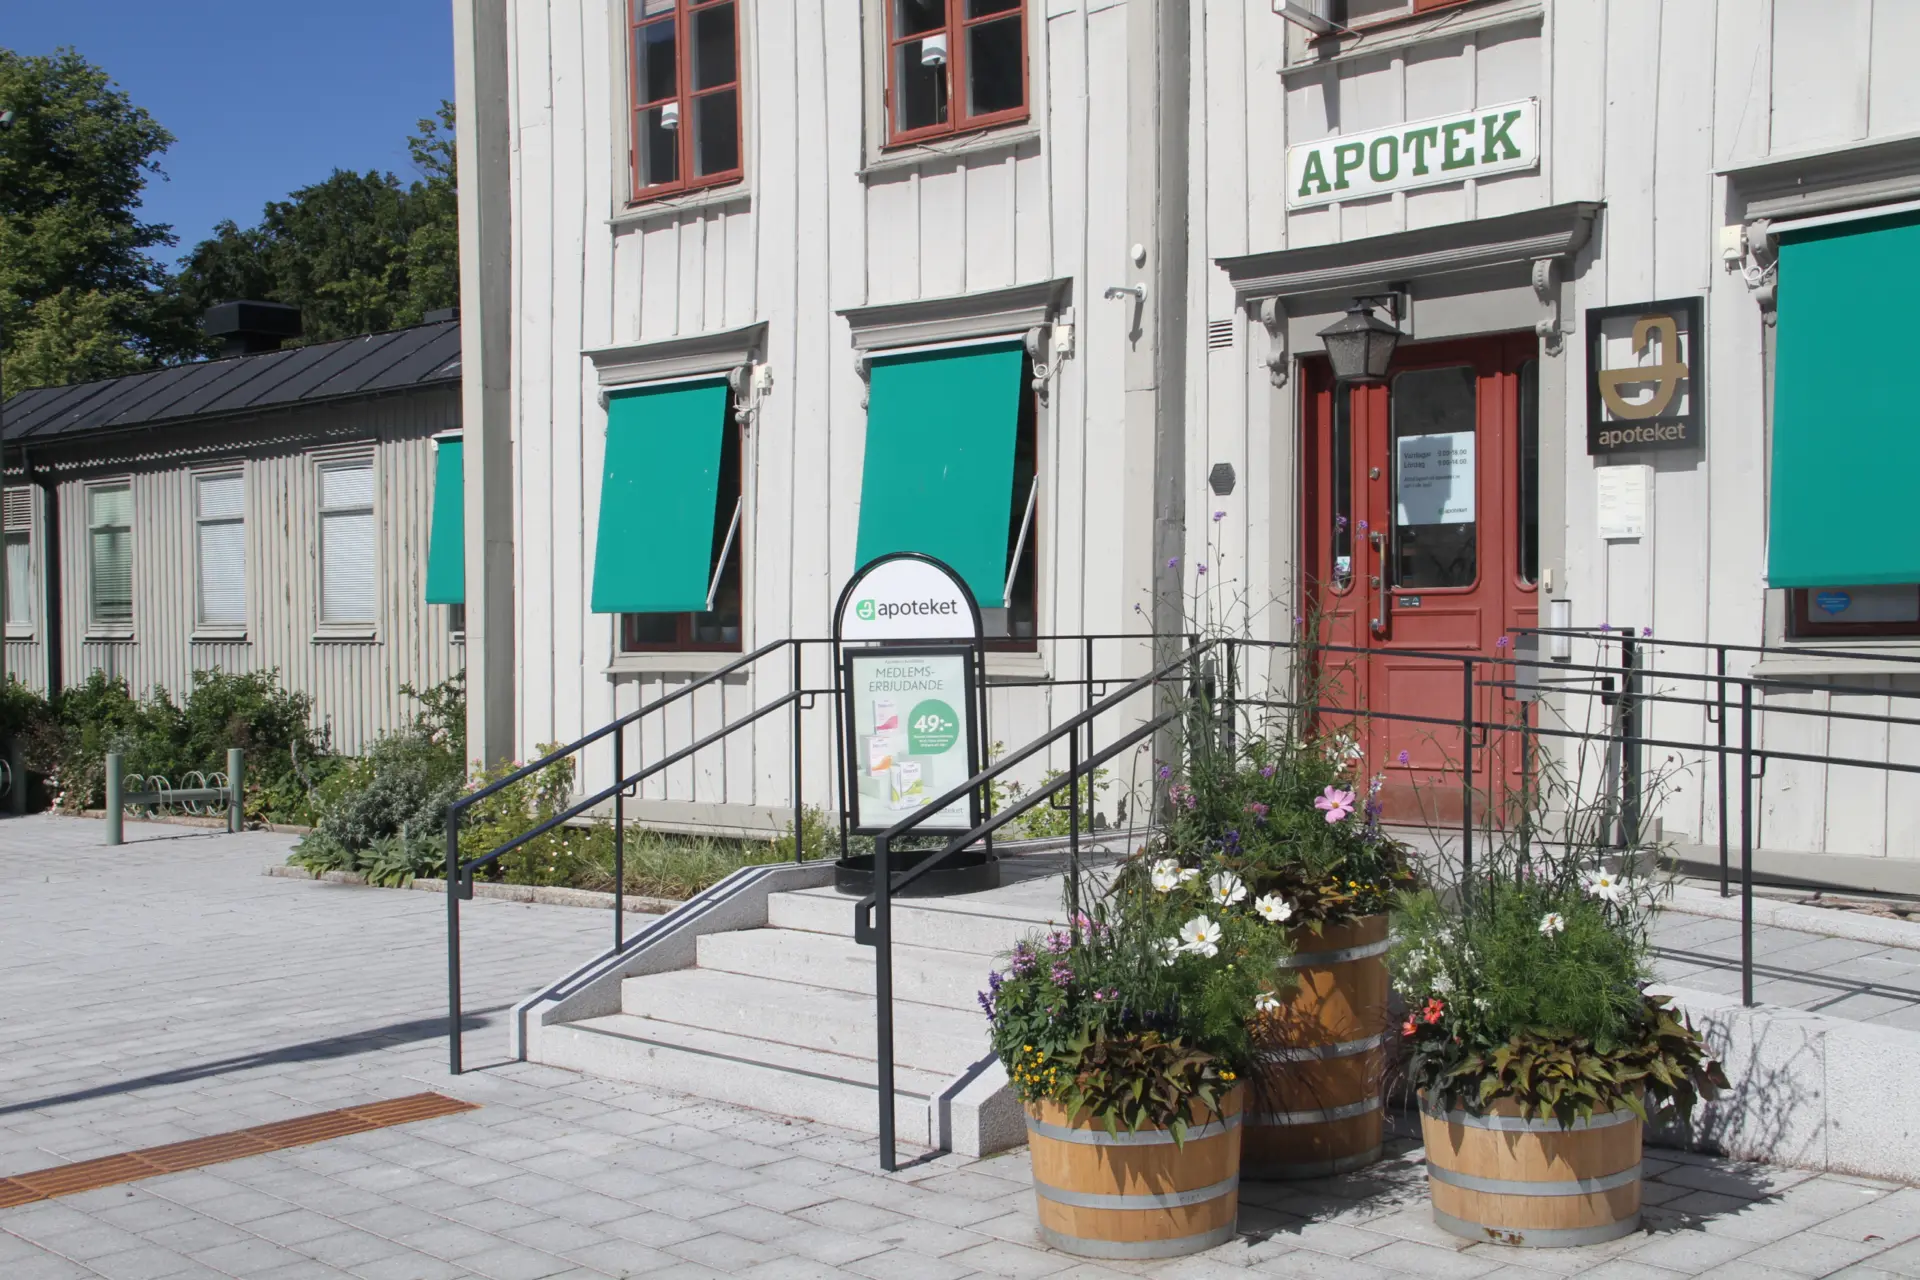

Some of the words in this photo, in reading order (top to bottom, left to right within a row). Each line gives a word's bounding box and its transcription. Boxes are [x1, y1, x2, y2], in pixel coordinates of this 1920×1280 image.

[1298, 110, 1522, 197] APOTEK
[1598, 422, 1686, 448] apoteket
[878, 598, 958, 619] apoteket
[876, 666, 936, 678] MEDLEMS-
[868, 680, 944, 692] ERBJUDANDE
[914, 714, 953, 733] 49:-
